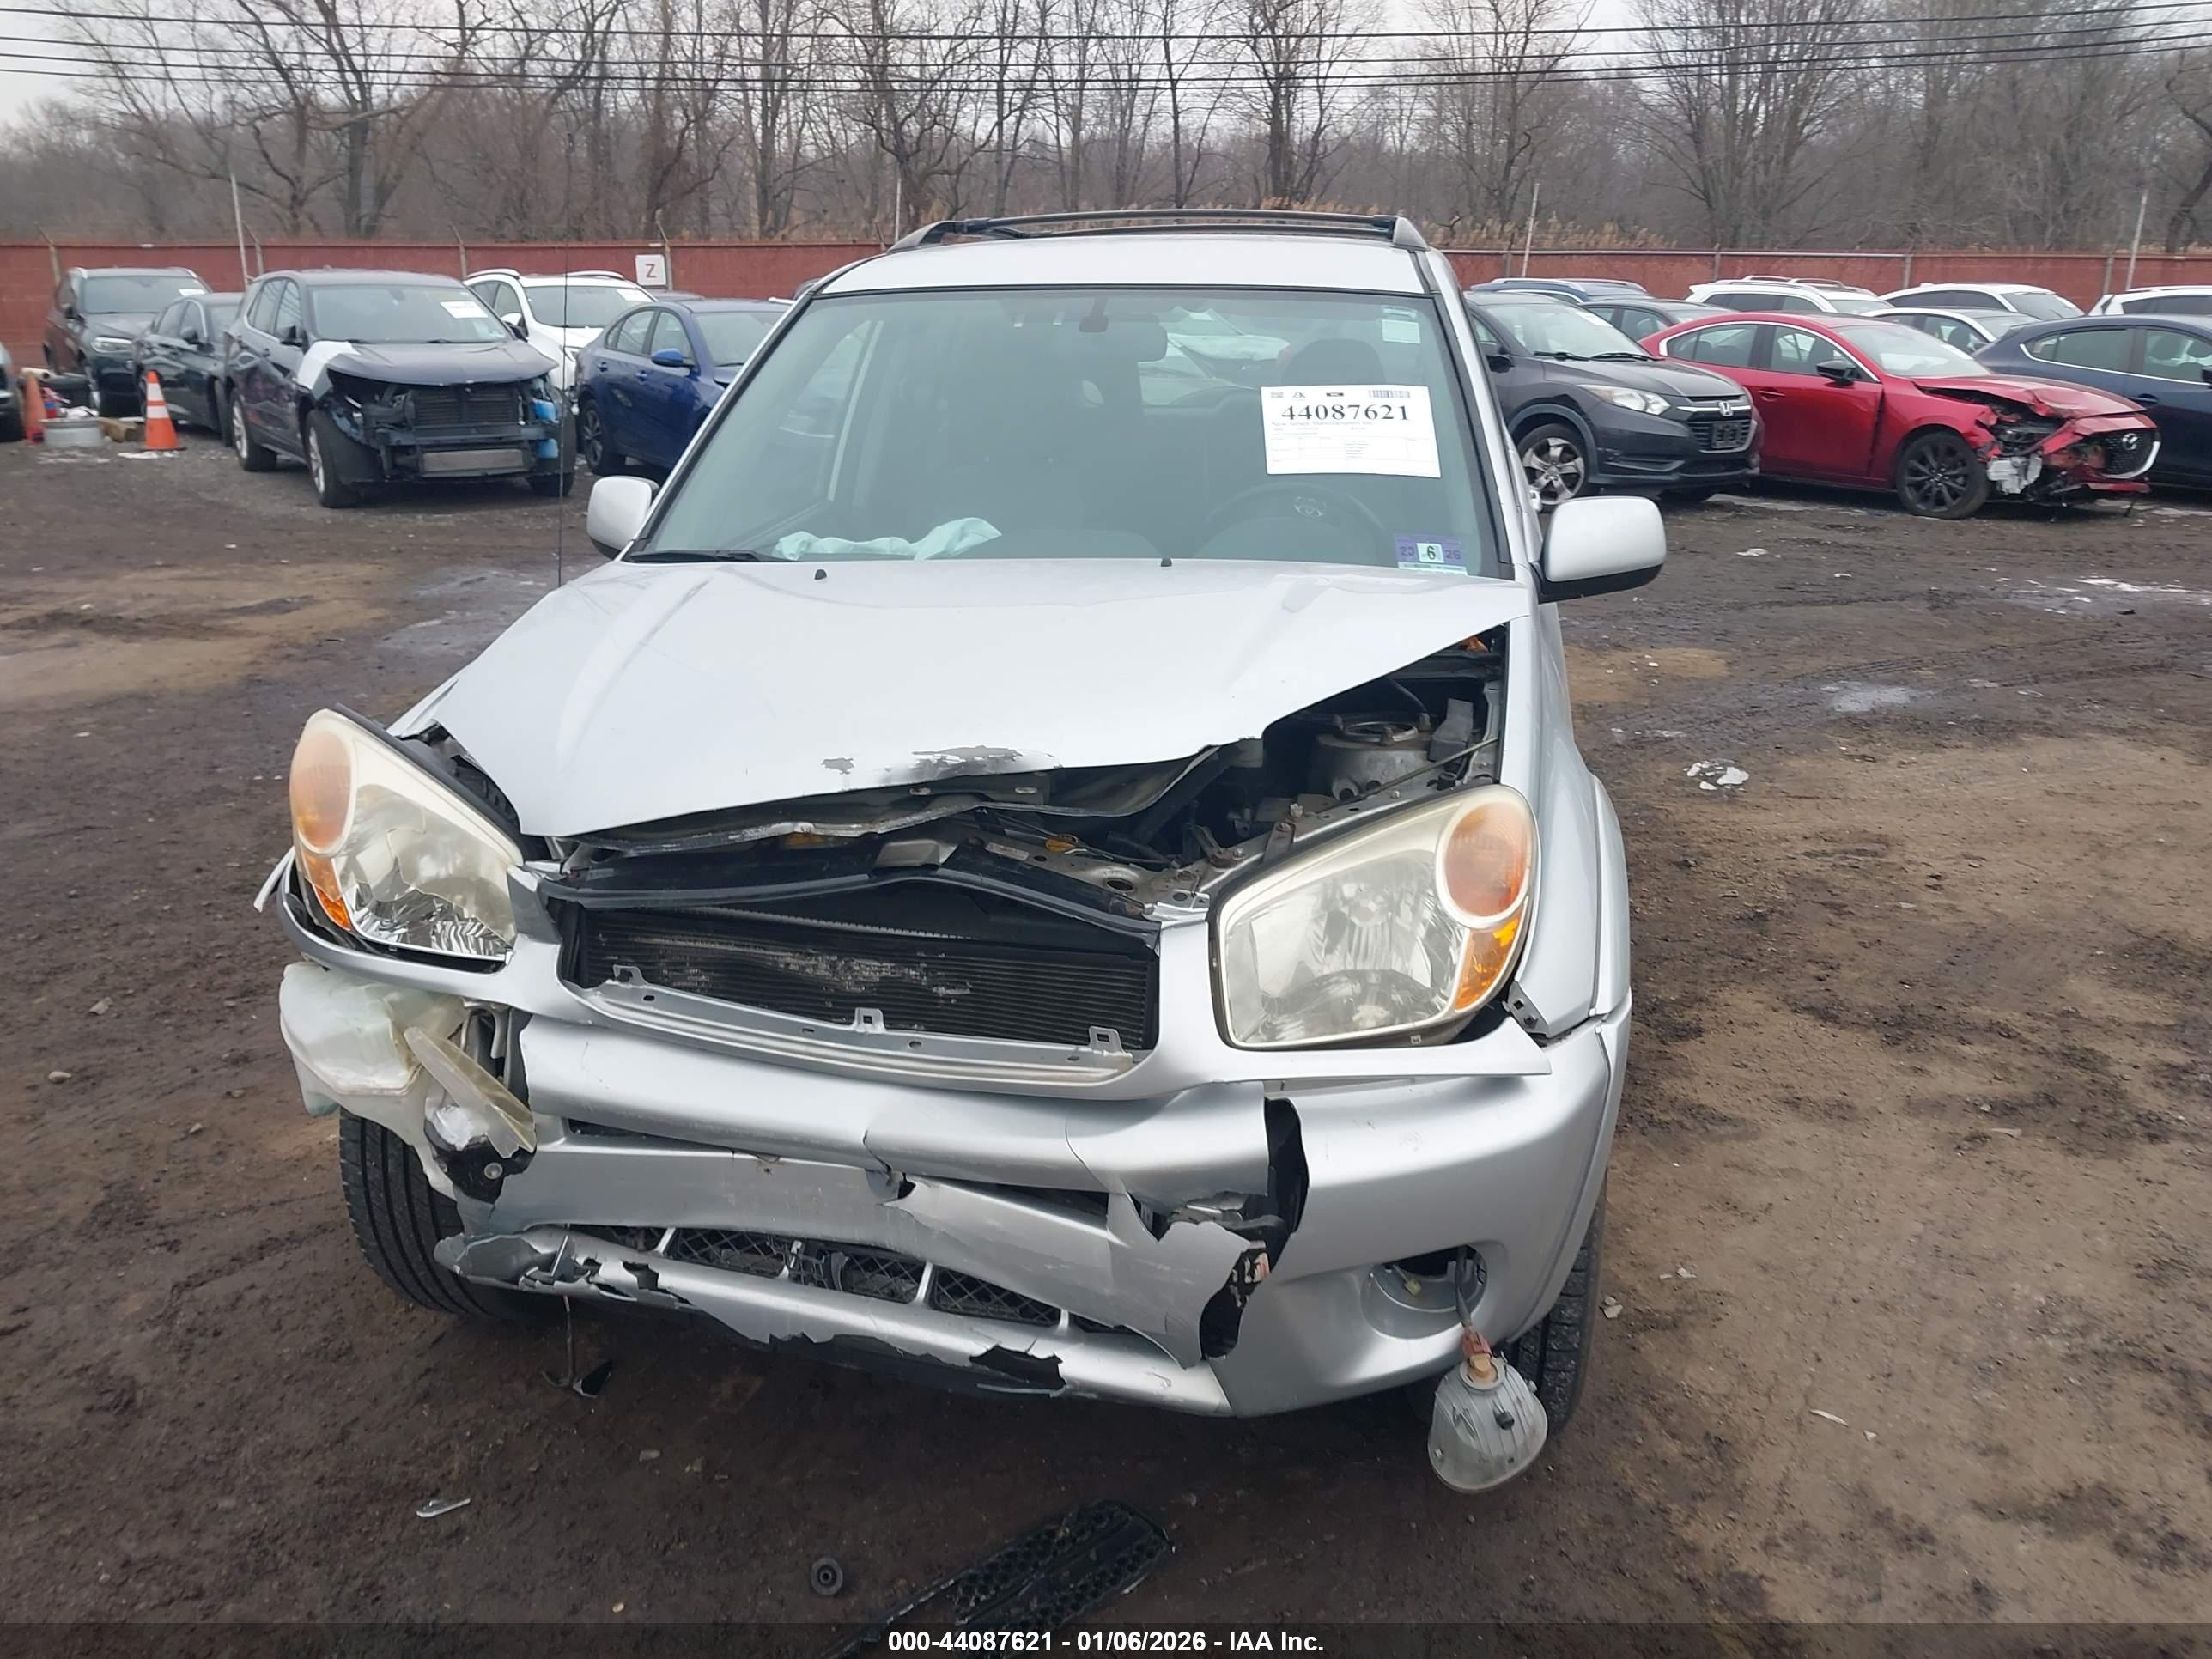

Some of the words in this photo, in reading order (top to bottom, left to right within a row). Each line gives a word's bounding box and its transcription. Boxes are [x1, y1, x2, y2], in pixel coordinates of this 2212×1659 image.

[645, 263, 657, 278] Z
[1281, 404, 1408, 420] 44087621
[1426, 545, 1437, 561] 6
